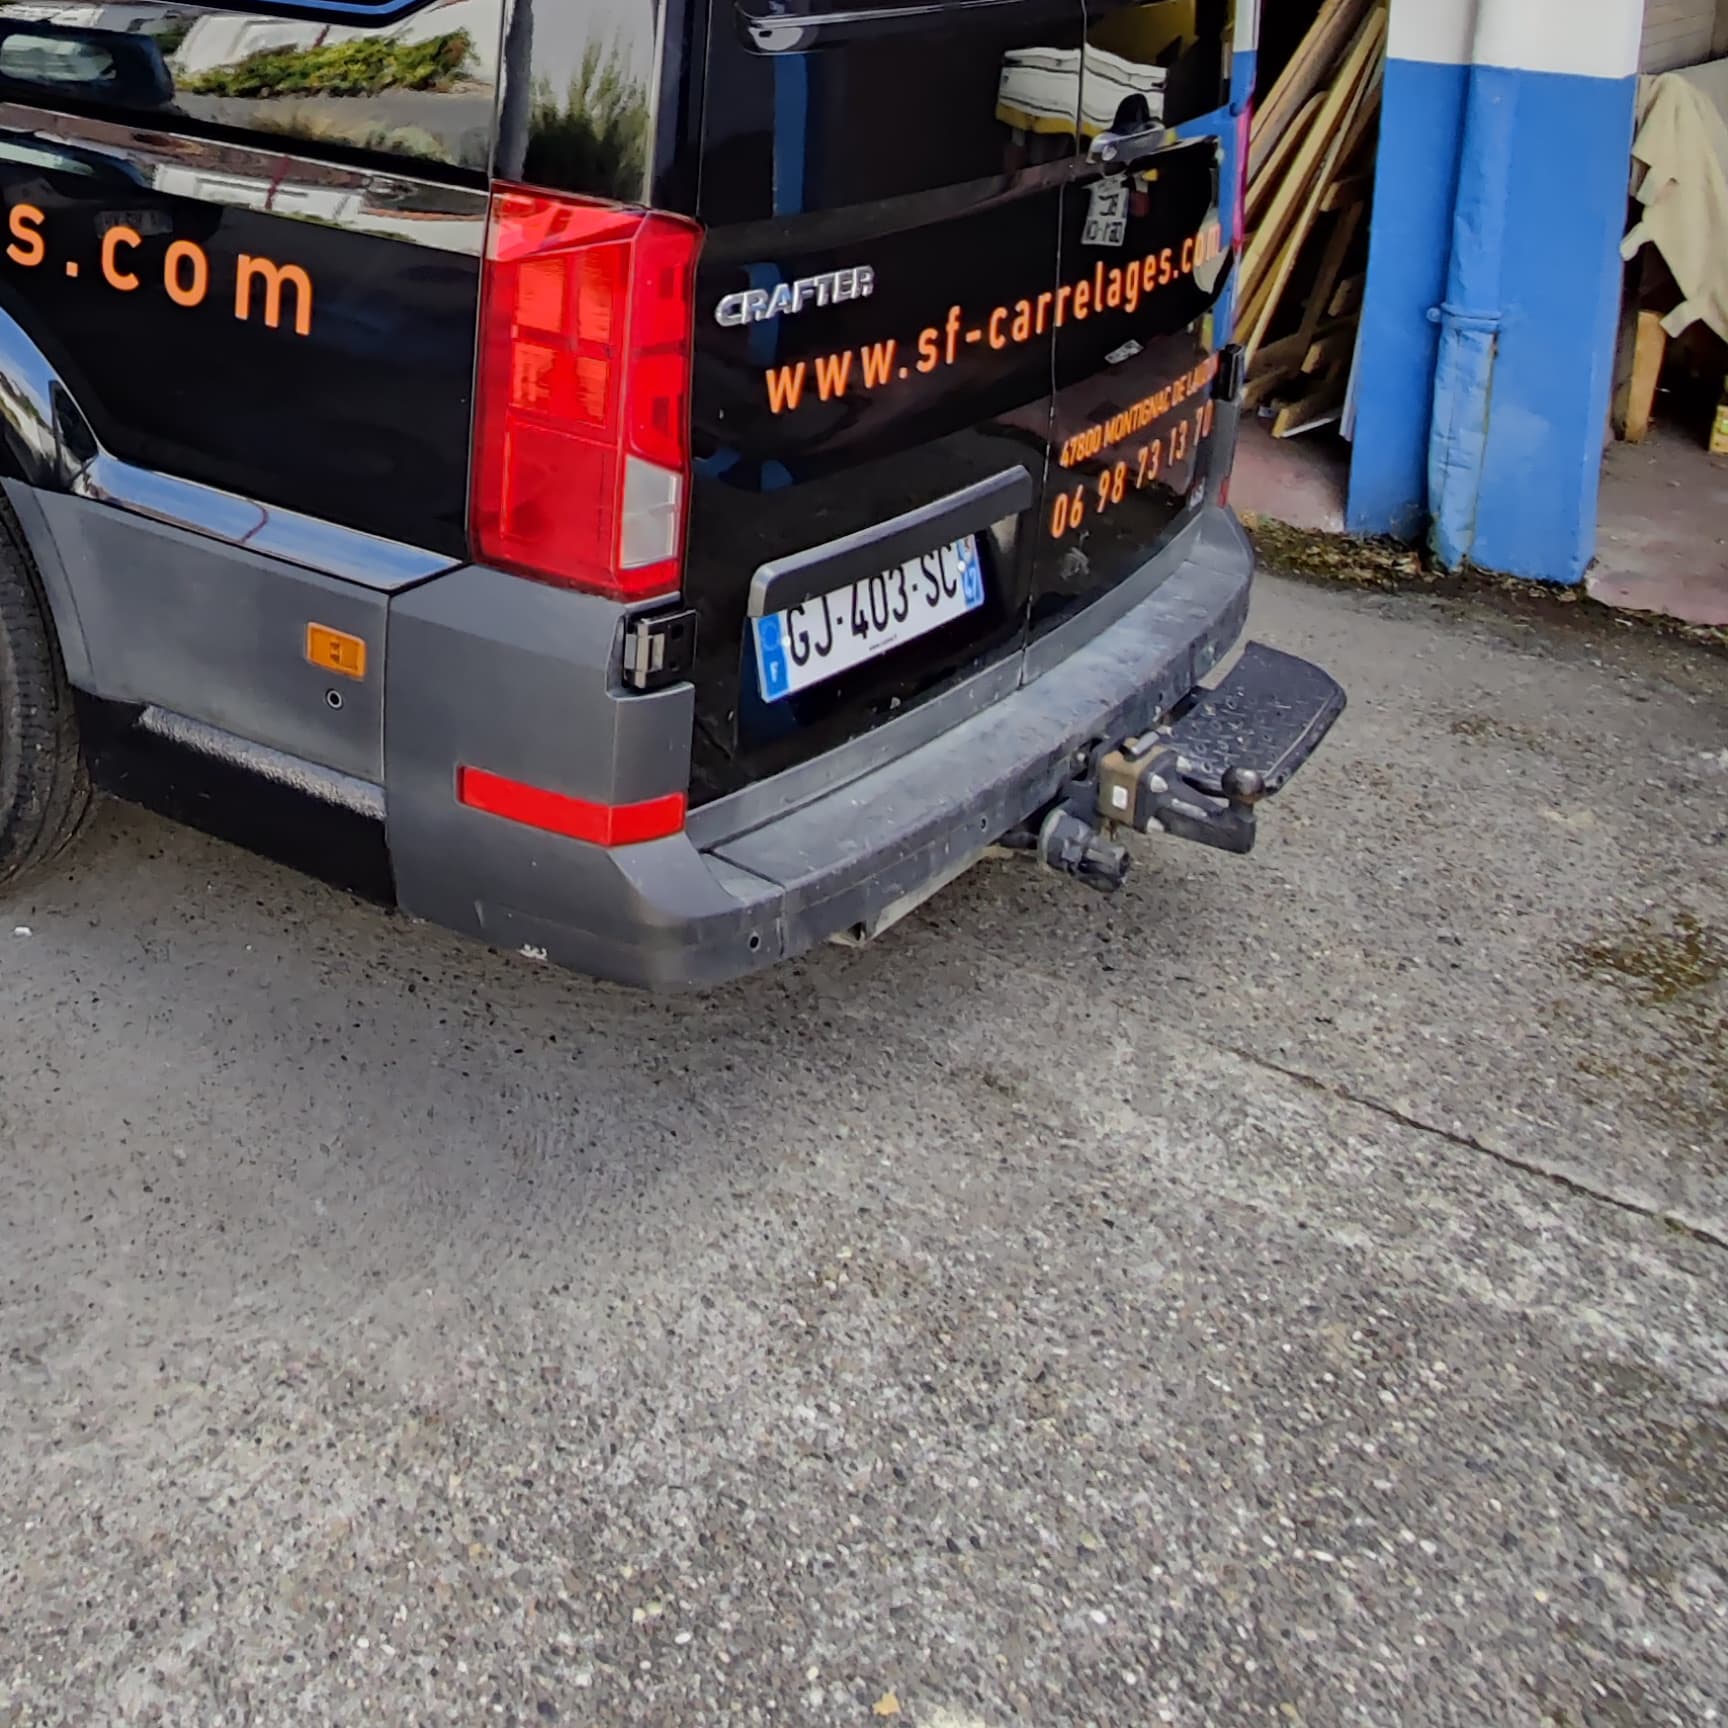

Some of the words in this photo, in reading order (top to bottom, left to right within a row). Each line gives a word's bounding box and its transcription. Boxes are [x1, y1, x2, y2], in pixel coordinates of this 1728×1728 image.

[715, 265, 874, 327] CRAFTER
[766, 223, 1221, 414] www.sf-carrelages.com
[1051, 483, 1084, 539] 06
[1097, 461, 1127, 513] 98
[1136, 438, 1161, 489] 73
[1168, 420, 1188, 466] 13
[1059, 424, 1102, 468] 47800
